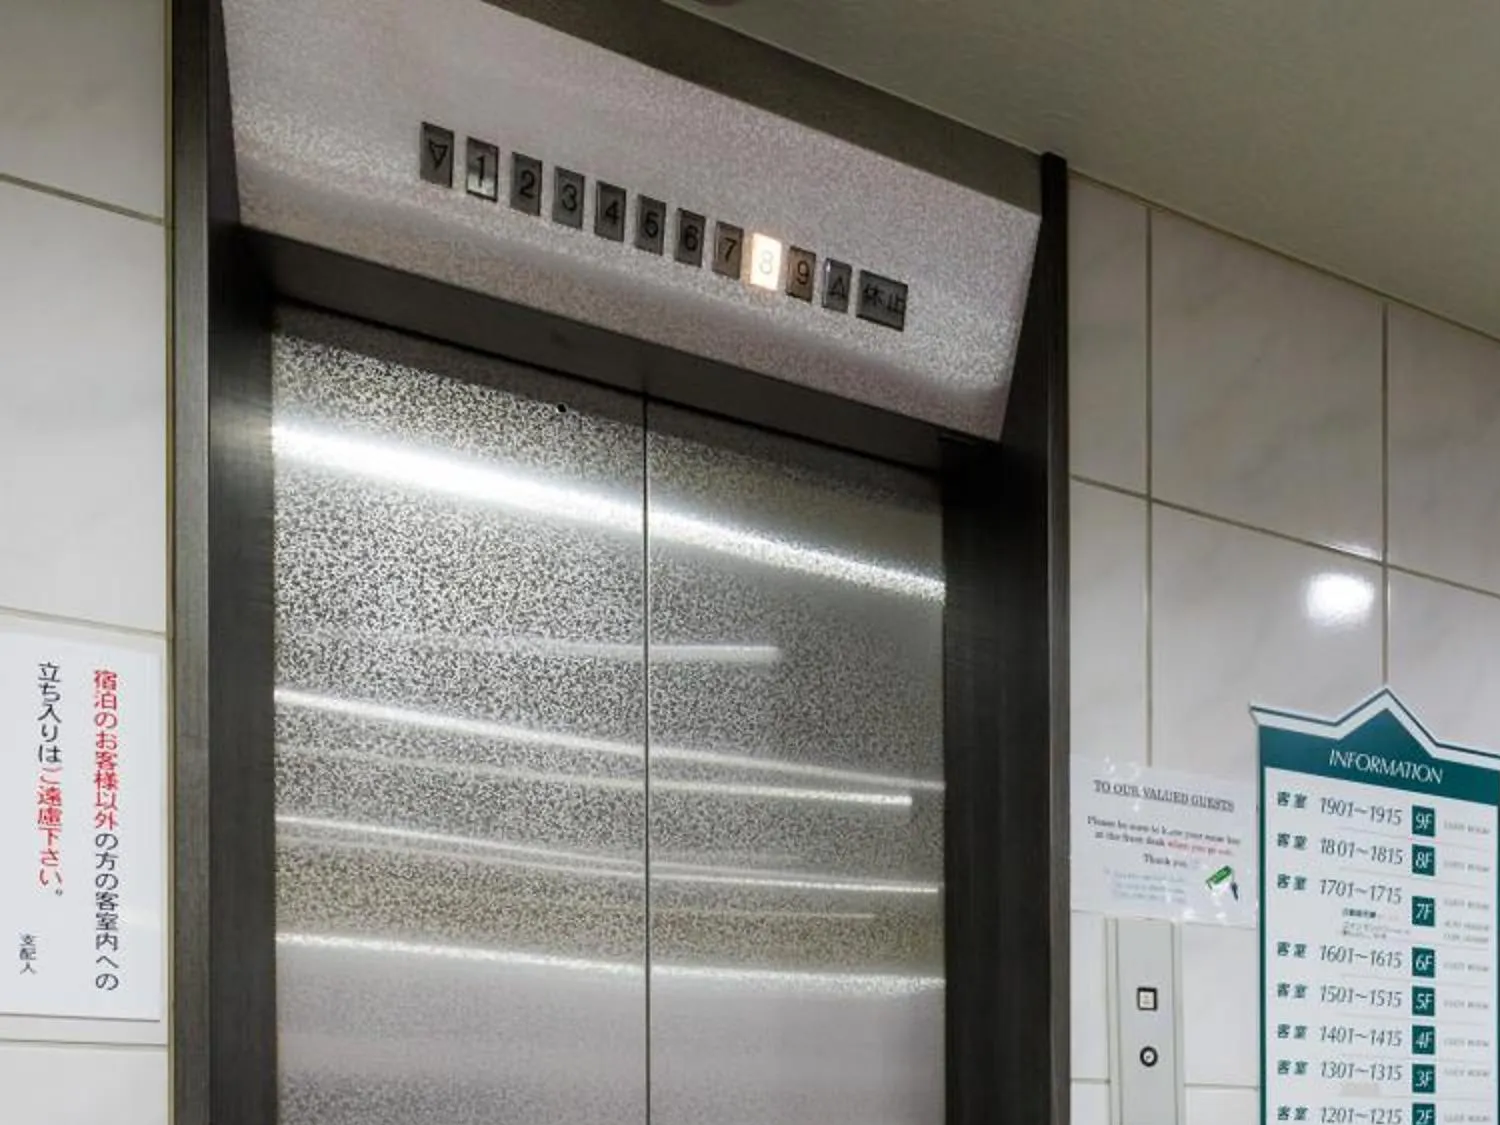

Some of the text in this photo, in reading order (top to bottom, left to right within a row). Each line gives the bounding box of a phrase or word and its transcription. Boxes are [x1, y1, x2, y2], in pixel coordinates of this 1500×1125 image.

[518, 168, 537, 199] 2
[560, 183, 578, 213] 3
[602, 199, 620, 226] 4
[643, 210, 660, 239] 5
[682, 224, 699, 253] 6
[722, 236, 739, 264] 7
[758, 247, 775, 277] 8
[796, 259, 811, 287] 9
[1328, 749, 1445, 785] INFORMATION
[37, 661, 64, 896] 立ち入りはご遠慮下さい。
[1092, 779, 1236, 813] TO OUR VALUED GUESTS
[93, 669, 119, 992] 宿泊のお客様以外の方の客室内への
[1414, 811, 1434, 831] 9F
[1414, 850, 1434, 870] 8F
[1414, 902, 1434, 921] 7F
[19, 933, 37, 976] 支配人
[1414, 951, 1434, 971] 6F
[1414, 991, 1434, 1010] 5F
[1414, 1030, 1434, 1049] 4F
[1414, 1069, 1434, 1088] 3F
[1414, 1108, 1434, 1125] 2F
